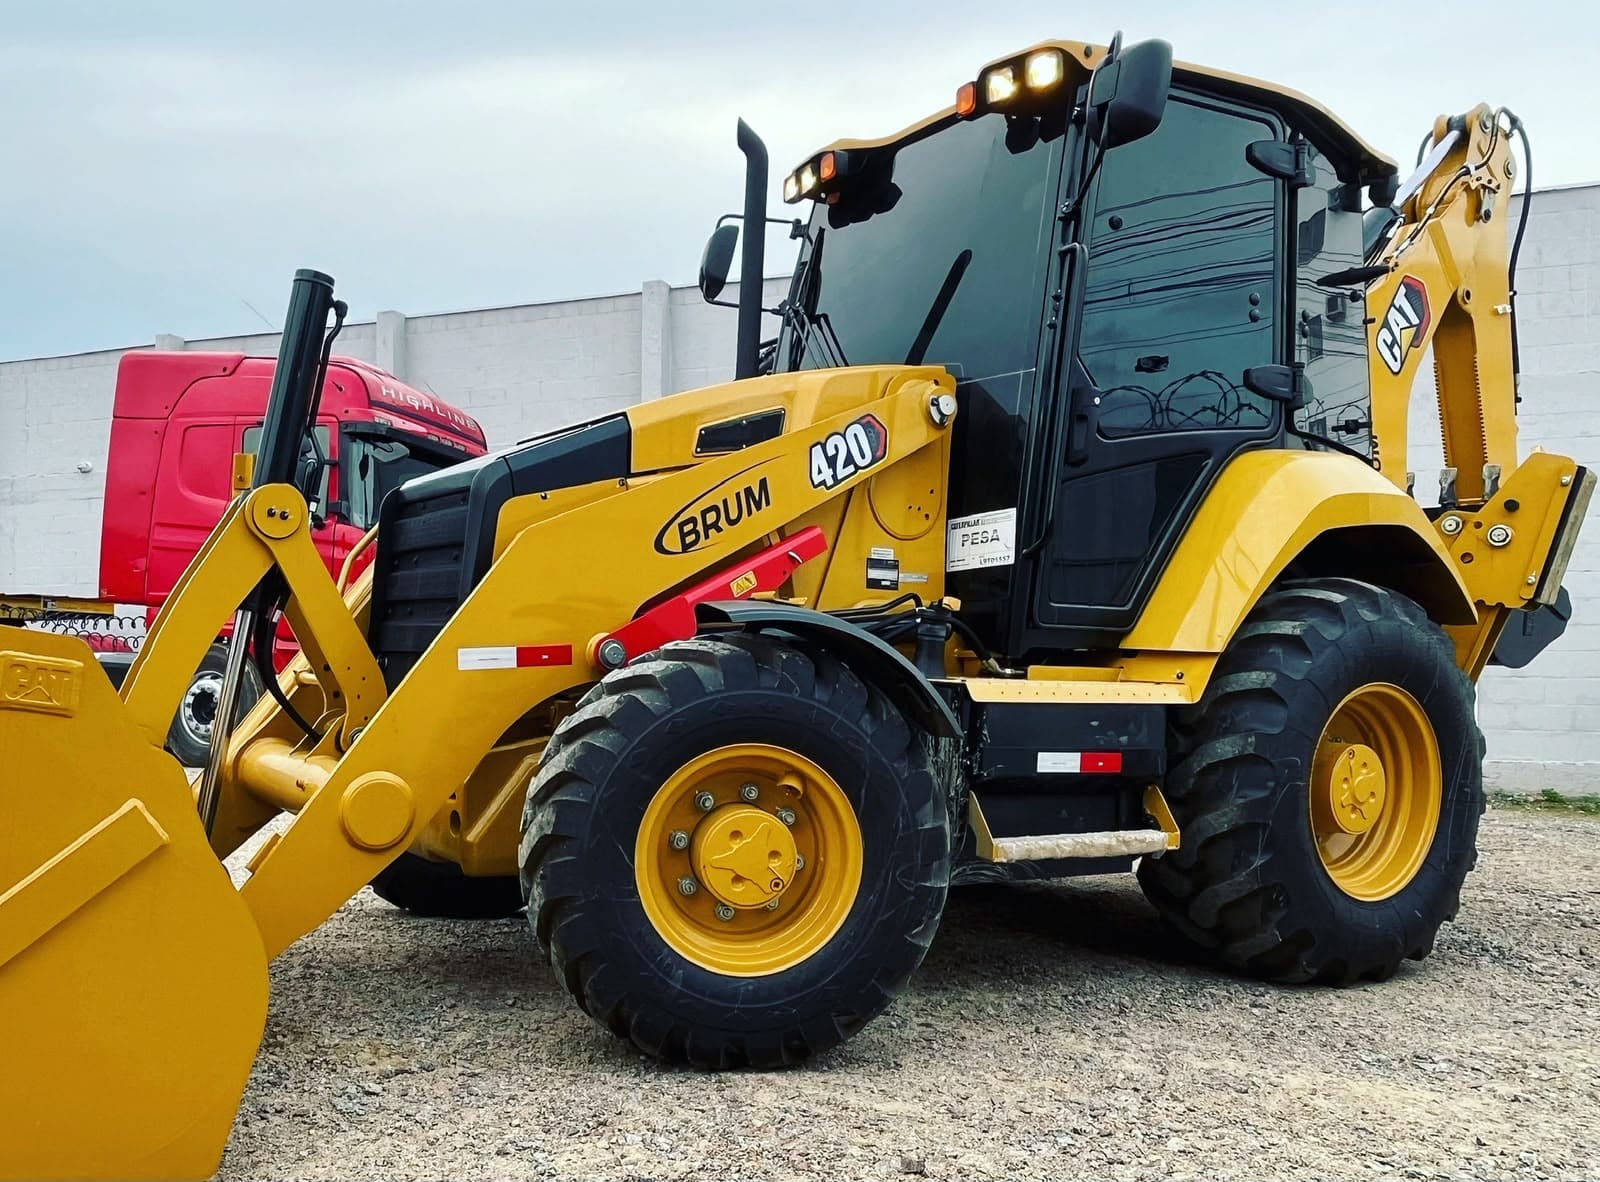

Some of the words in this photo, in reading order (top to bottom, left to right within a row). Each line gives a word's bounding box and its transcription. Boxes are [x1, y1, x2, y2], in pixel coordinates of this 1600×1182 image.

[1377, 283, 1420, 374] CAT
[381, 386, 478, 431] HIGHLINE
[811, 423, 873, 487] 420
[677, 476, 772, 552] BRUM
[961, 529, 1000, 548] PESA
[5, 663, 72, 706] CAT
